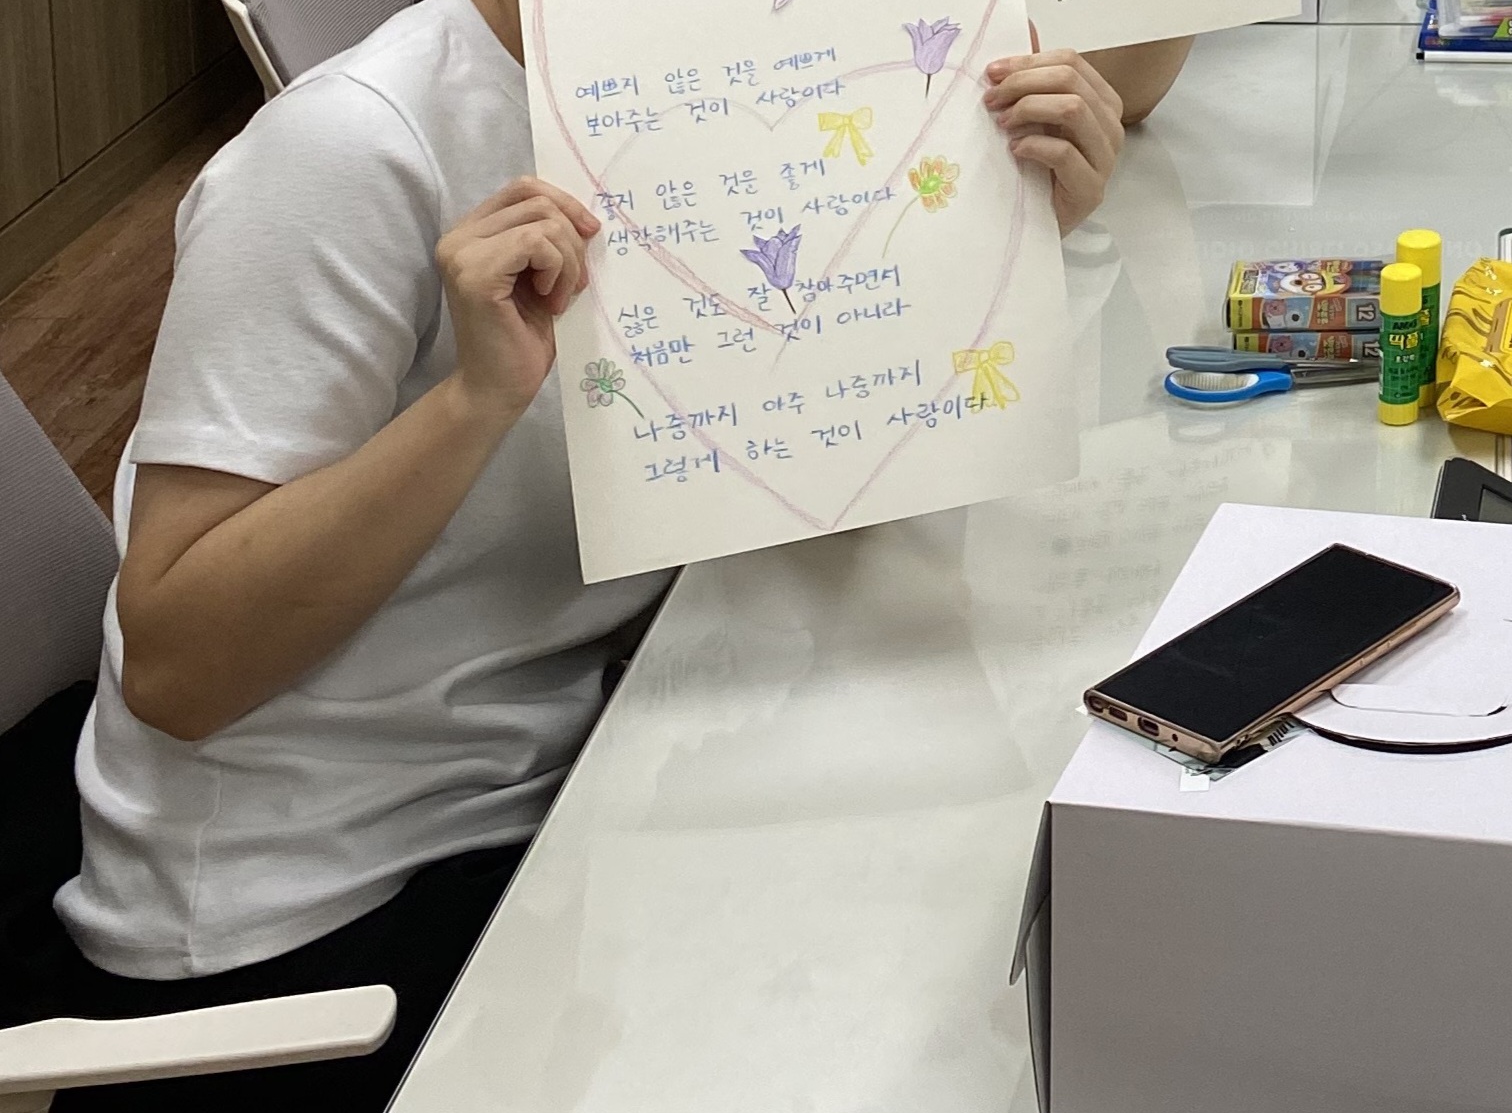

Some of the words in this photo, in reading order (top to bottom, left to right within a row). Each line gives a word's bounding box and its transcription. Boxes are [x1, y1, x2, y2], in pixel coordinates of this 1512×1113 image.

[575, 75, 639, 102] 예쁘지
[665, 68, 701, 95] 않은
[773, 47, 836, 71] 예쁘게
[586, 107, 663, 136] 보아주는
[684, 98, 729, 123] 것이
[755, 78, 845, 108] 사랑이다
[656, 181, 696, 210] 않은
[780, 159, 825, 190] 좋게
[608, 220, 720, 256] 생각해주는
[742, 207, 783, 231] 것이
[802, 187, 896, 216] 사랑이다
[748, 283, 772, 312] 잘
[1358, 305, 1375, 321] 12
[630, 335, 695, 366] 처음만
[718, 327, 756, 352] 그런
[774, 315, 821, 342] 것이
[836, 297, 912, 325] 아니라
[1389, 331, 1419, 350] 딱풀
[633, 402, 737, 441] 나중까지
[762, 392, 804, 414] 아주
[826, 359, 921, 399] 나중까지
[644, 449, 720, 483] 그렇게
[746, 438, 793, 460] 하는
[811, 420, 862, 448] 것이
